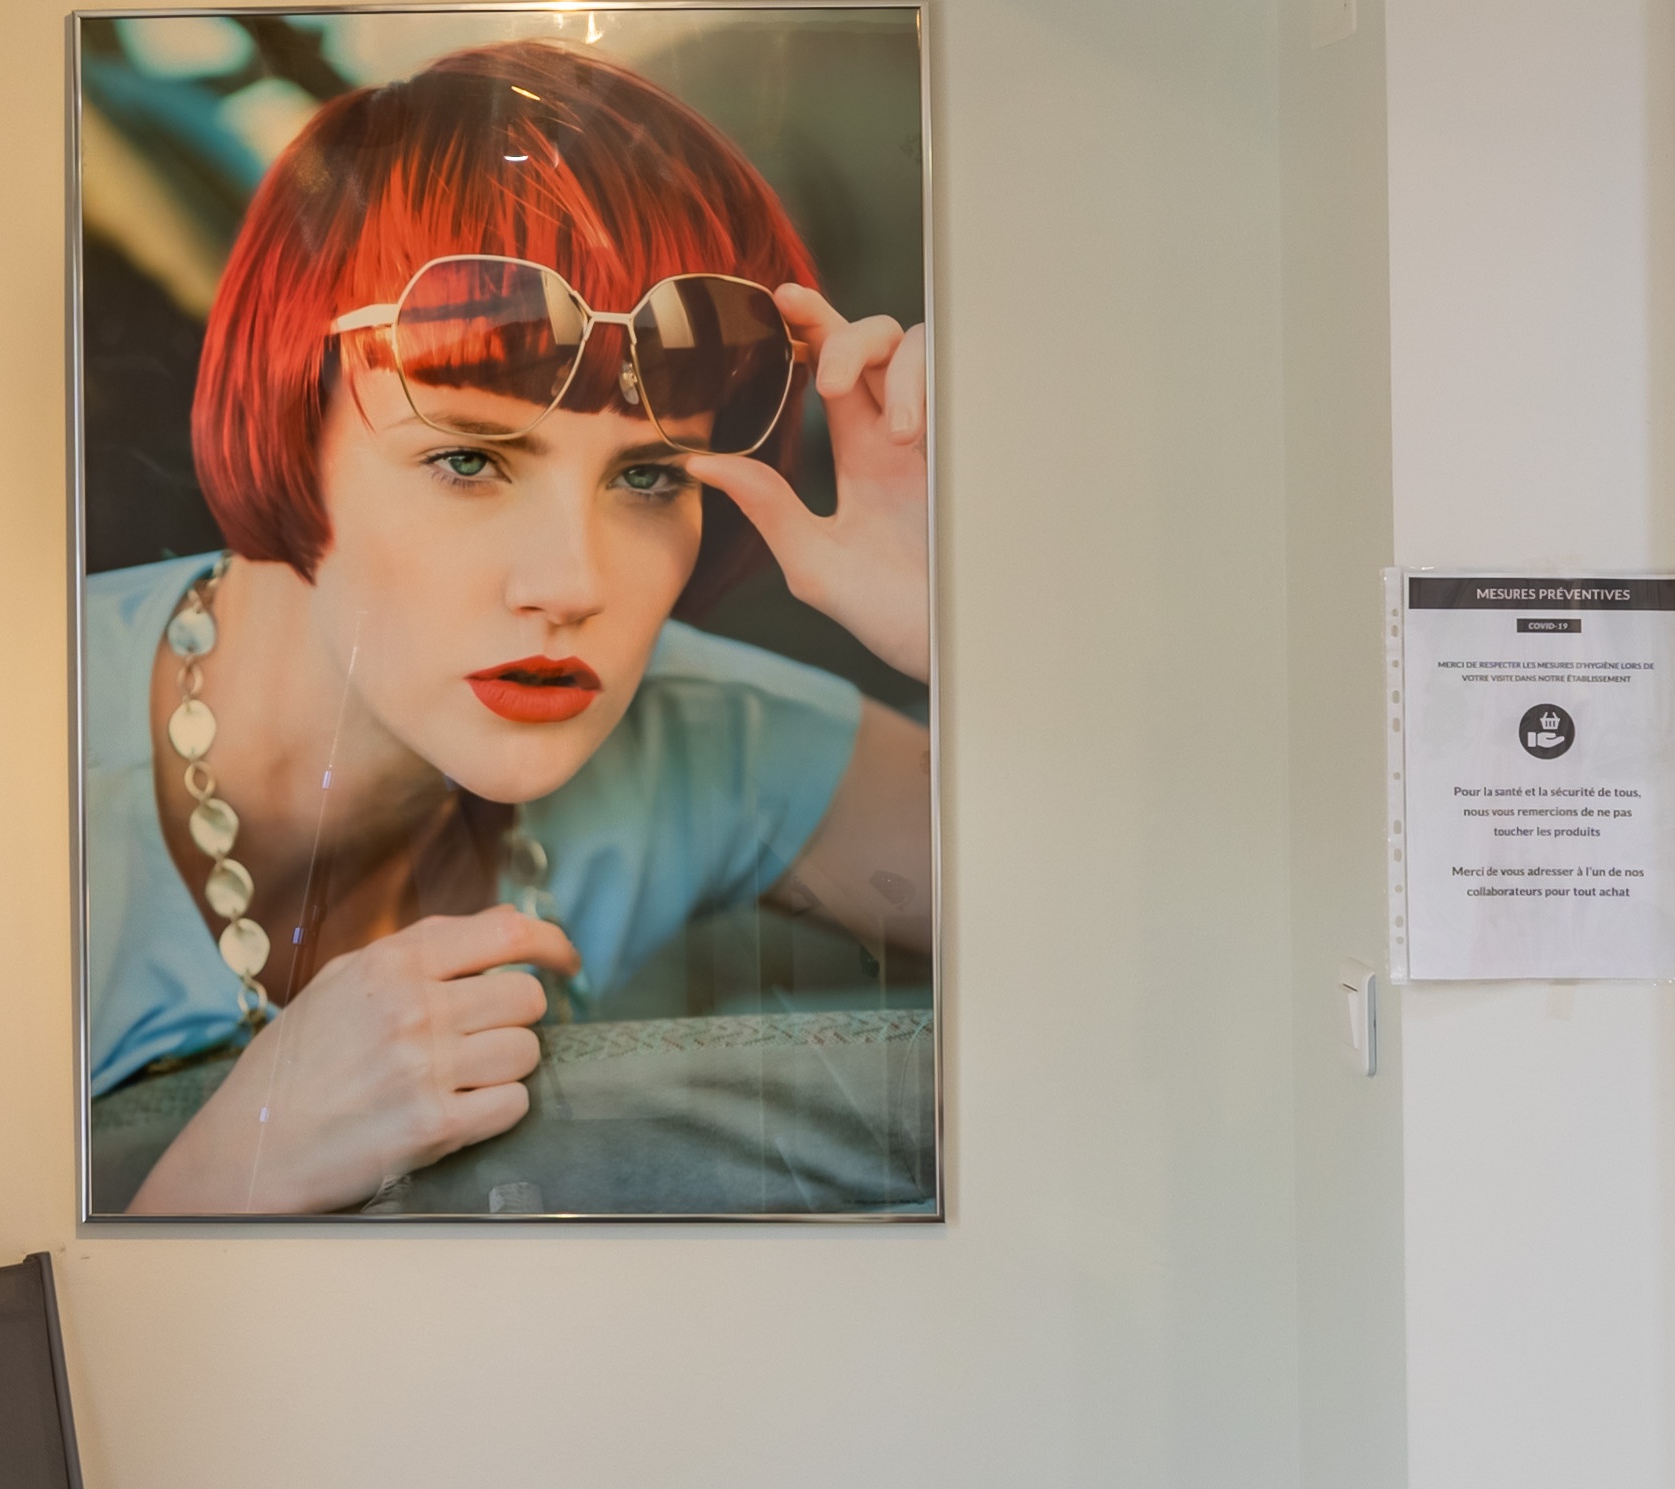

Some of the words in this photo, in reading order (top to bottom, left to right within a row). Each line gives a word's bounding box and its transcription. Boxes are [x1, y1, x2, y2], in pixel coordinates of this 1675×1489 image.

[1476, 588, 1536, 600] MESURES
[1539, 586, 1631, 601] PRÉVENTIVES
[1528, 622, 1568, 631] COVID-19
[1438, 661, 1465, 669] MERCI
[1466, 661, 1478, 669] DE
[1479, 661, 1521, 669] RESPECTER
[1522, 662, 1536, 670] LES
[1537, 661, 1575, 670] MESURES
[1621, 662, 1642, 670] LORS
[1643, 662, 1655, 670] DE
[1461, 674, 1489, 683] VOTRE
[1490, 674, 1514, 683] VISITE
[1515, 674, 1537, 683] DANS
[1538, 674, 1565, 683] NOTRE
[1567, 673, 1632, 683] ÉTABLISSEMENT
[1454, 787, 1481, 797] Pour
[1483, 787, 1493, 797] la
[1495, 786, 1523, 797] santé
[1525, 788, 1536, 797] et
[1538, 787, 1549, 797] la
[1551, 787, 1595, 798] sécurité
[1597, 787, 1612, 798] de
[1614, 789, 1642, 799] tous,
[1463, 809, 1490, 817] nous
[1491, 809, 1516, 817] vous
[1517, 807, 1579, 817] remercions
[1580, 807, 1595, 818] de
[1597, 809, 1611, 818] ne
[1613, 809, 1633, 819] pas
[1494, 827, 1534, 837] toucher
[1536, 827, 1552, 837] les
[1554, 827, 1601, 838] produits
[1452, 867, 1485, 877] Merci
[1486, 867, 1498, 877] de
[1500, 869, 1525, 877] vous
[1527, 867, 1573, 877] adresser
[1608, 867, 1622, 878] de
[1624, 869, 1645, 878] nos
[1466, 886, 1543, 897] collaborateurs
[1545, 889, 1570, 899] pour
[1573, 888, 1596, 897] tout
[1598, 887, 1630, 897] achat
